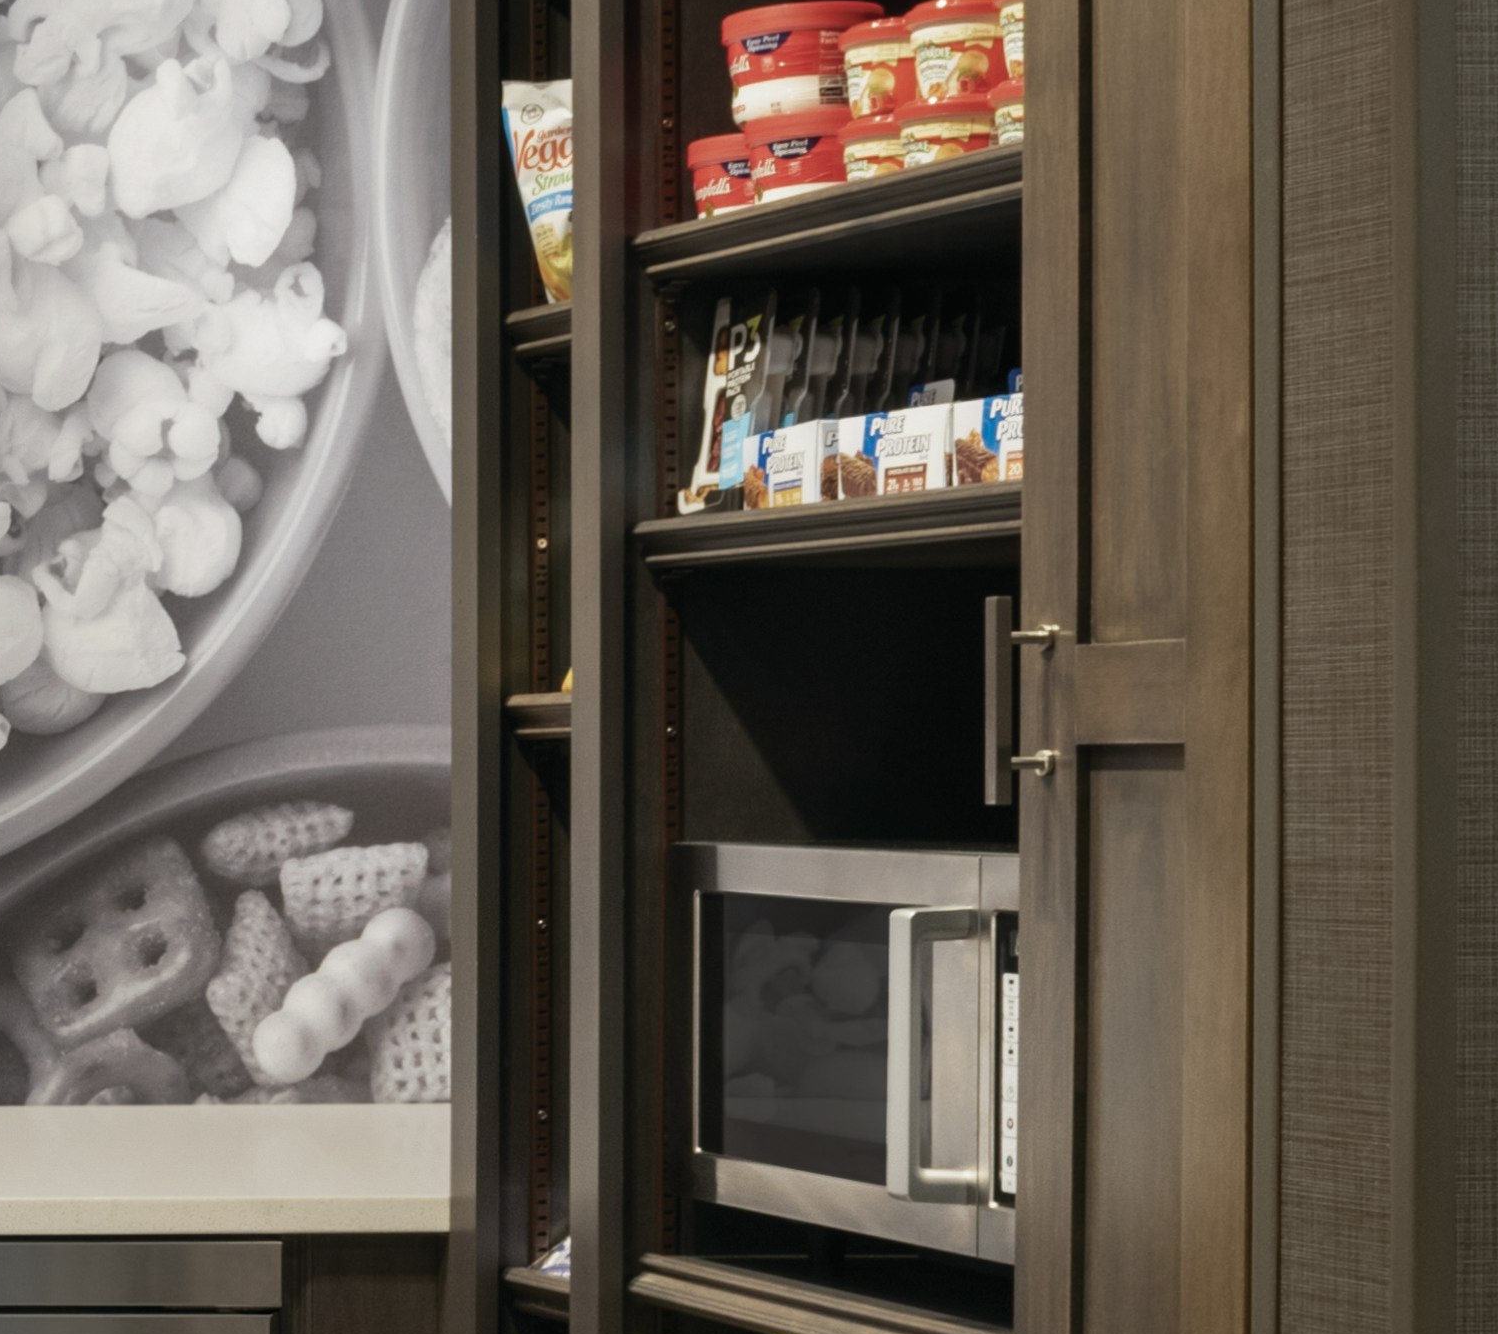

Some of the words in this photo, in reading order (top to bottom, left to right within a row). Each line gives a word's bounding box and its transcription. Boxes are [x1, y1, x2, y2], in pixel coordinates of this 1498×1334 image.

[870, 415, 907, 437] PURE
[762, 434, 787, 455] PURE
[875, 432, 931, 459] PROTEIN
[766, 451, 806, 476] PROTEIN
